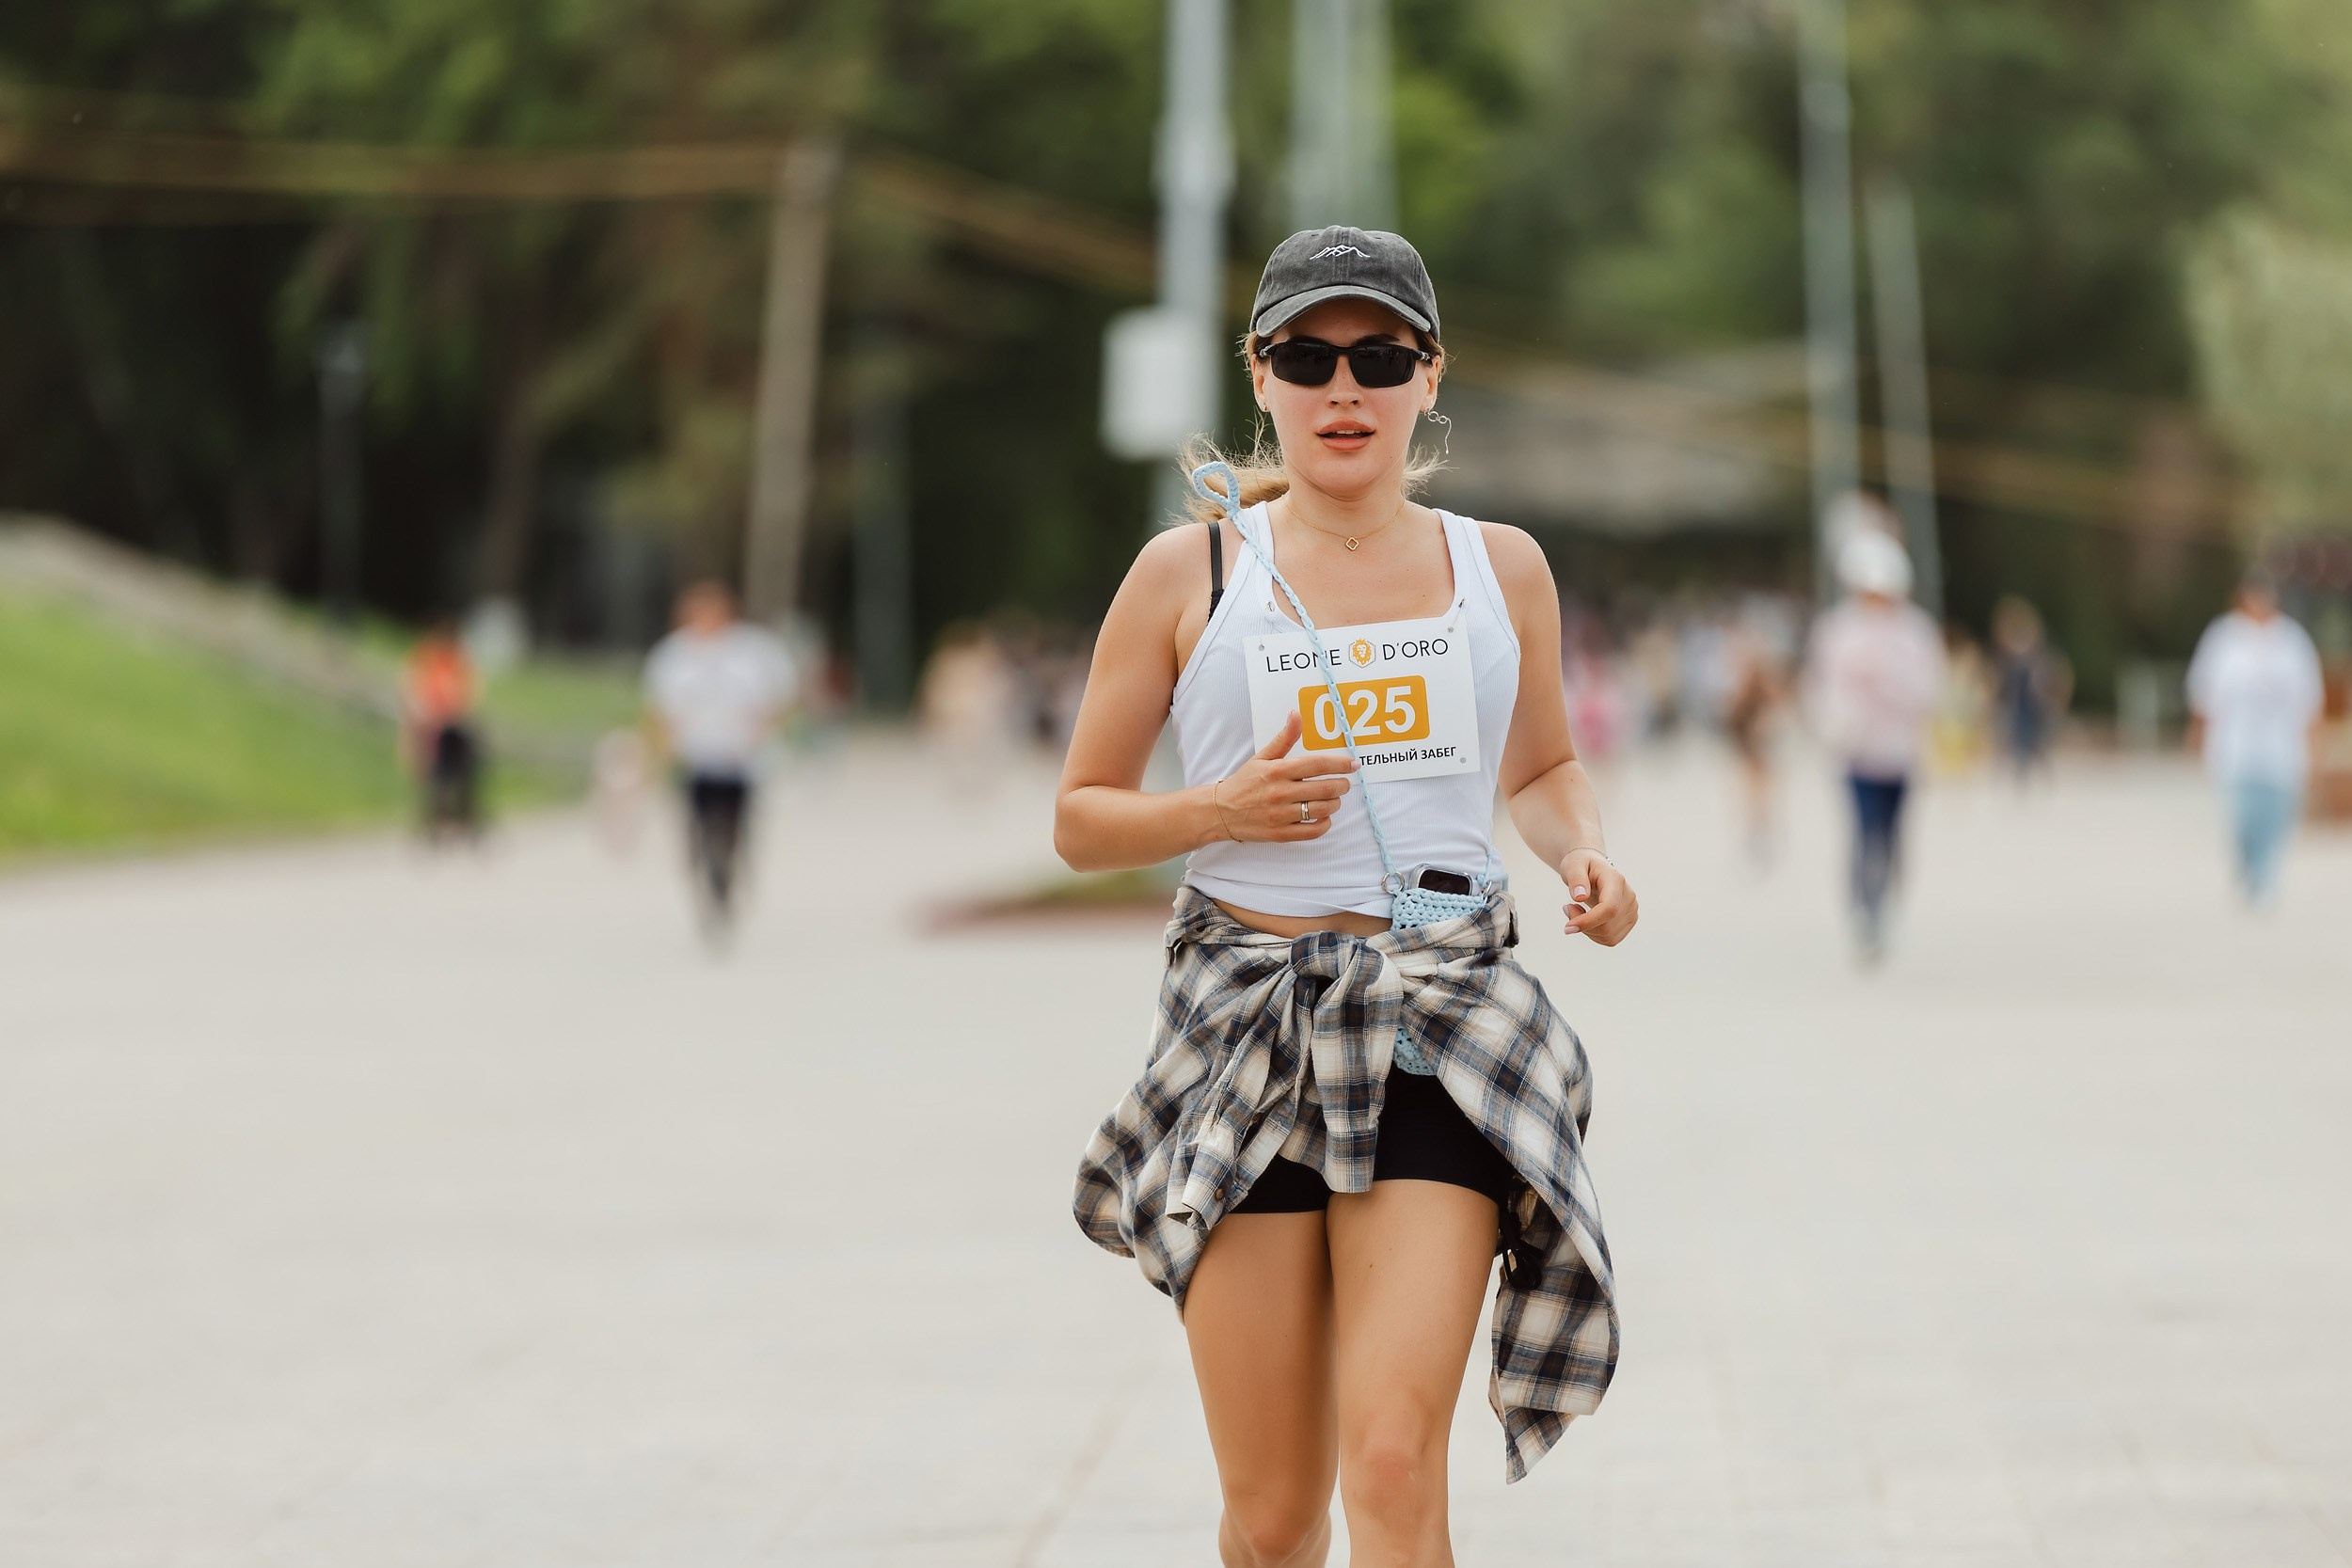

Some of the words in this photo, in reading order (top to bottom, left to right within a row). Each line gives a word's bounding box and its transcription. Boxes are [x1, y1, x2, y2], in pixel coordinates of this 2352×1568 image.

[1382, 638, 1449, 660] D'ORO
[1313, 685, 1416, 740] 025
[1359, 749, 1418, 766] ТЕЛЬНЫЙ
[1421, 746, 1456, 760] ЗАБЕГ
